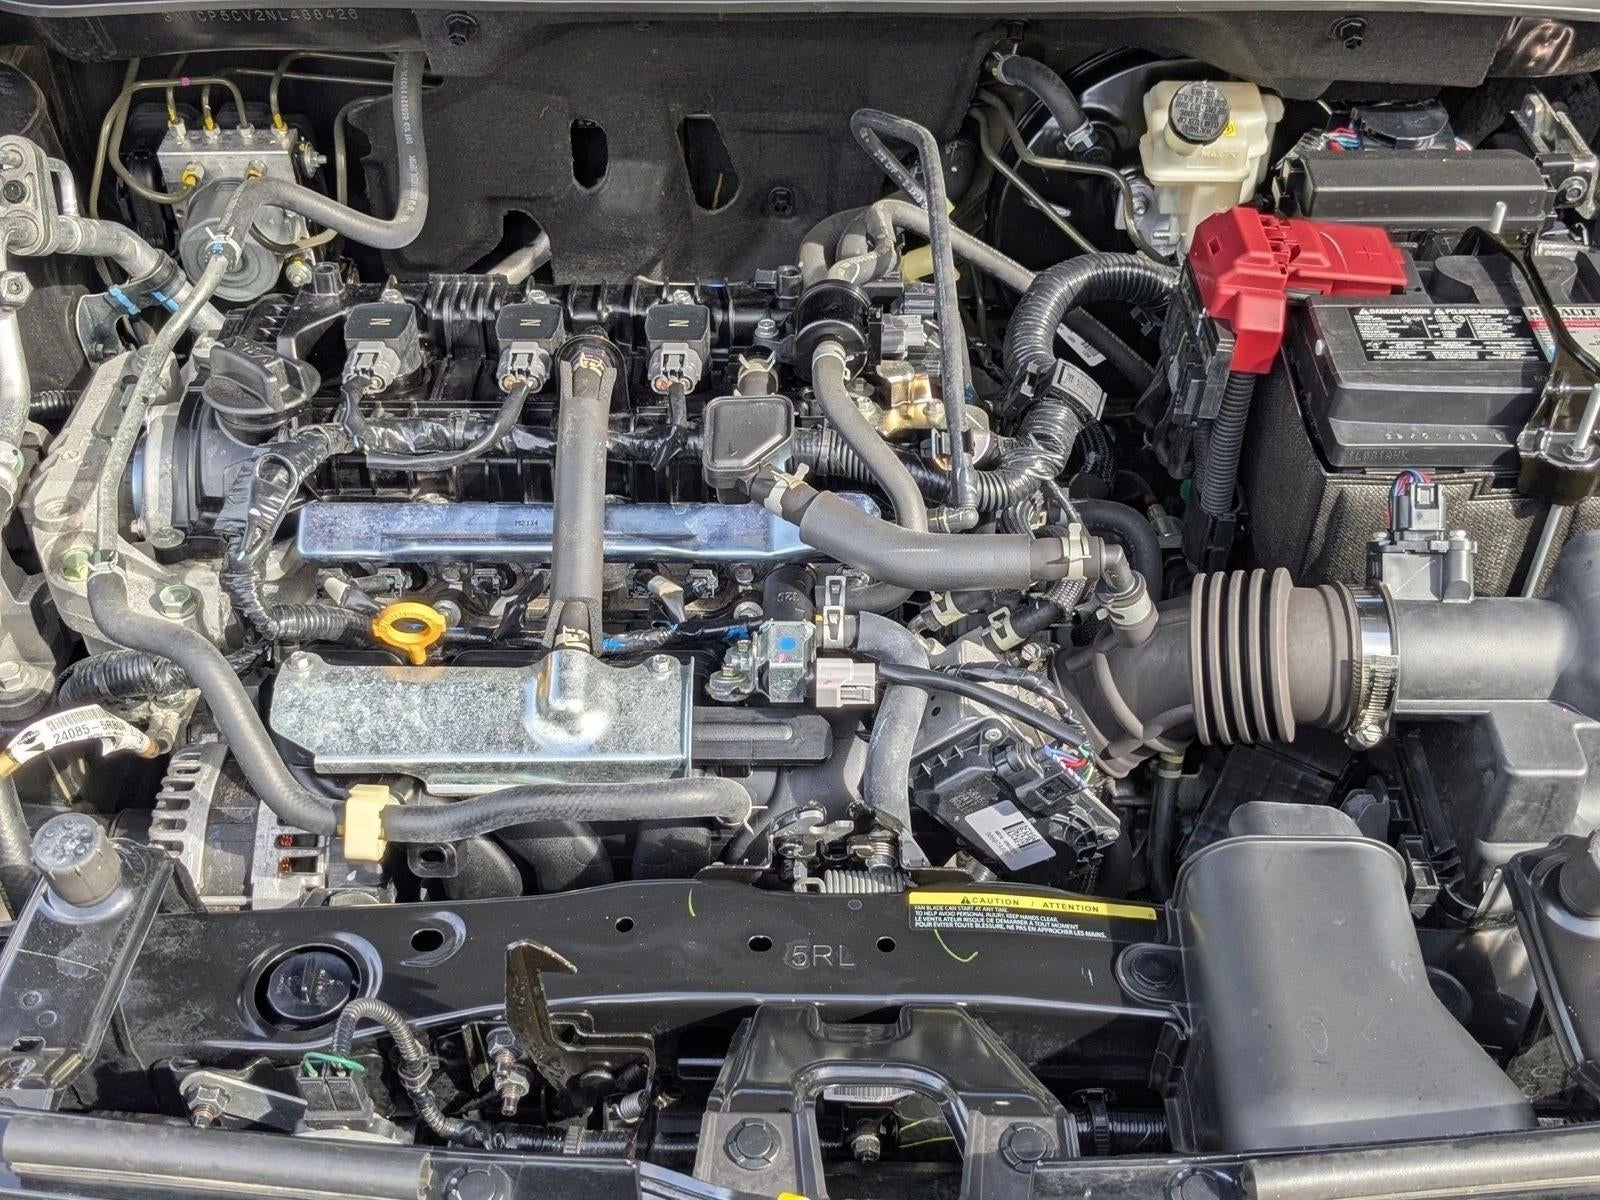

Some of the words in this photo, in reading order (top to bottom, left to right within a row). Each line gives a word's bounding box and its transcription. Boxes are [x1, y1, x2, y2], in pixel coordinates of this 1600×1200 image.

[1528, 308, 1596, 316] RAULT
[972, 896, 1019, 906] CAUTION
[1042, 902, 1099, 912] ATTENTION
[791, 944, 856, 967] 5RL
